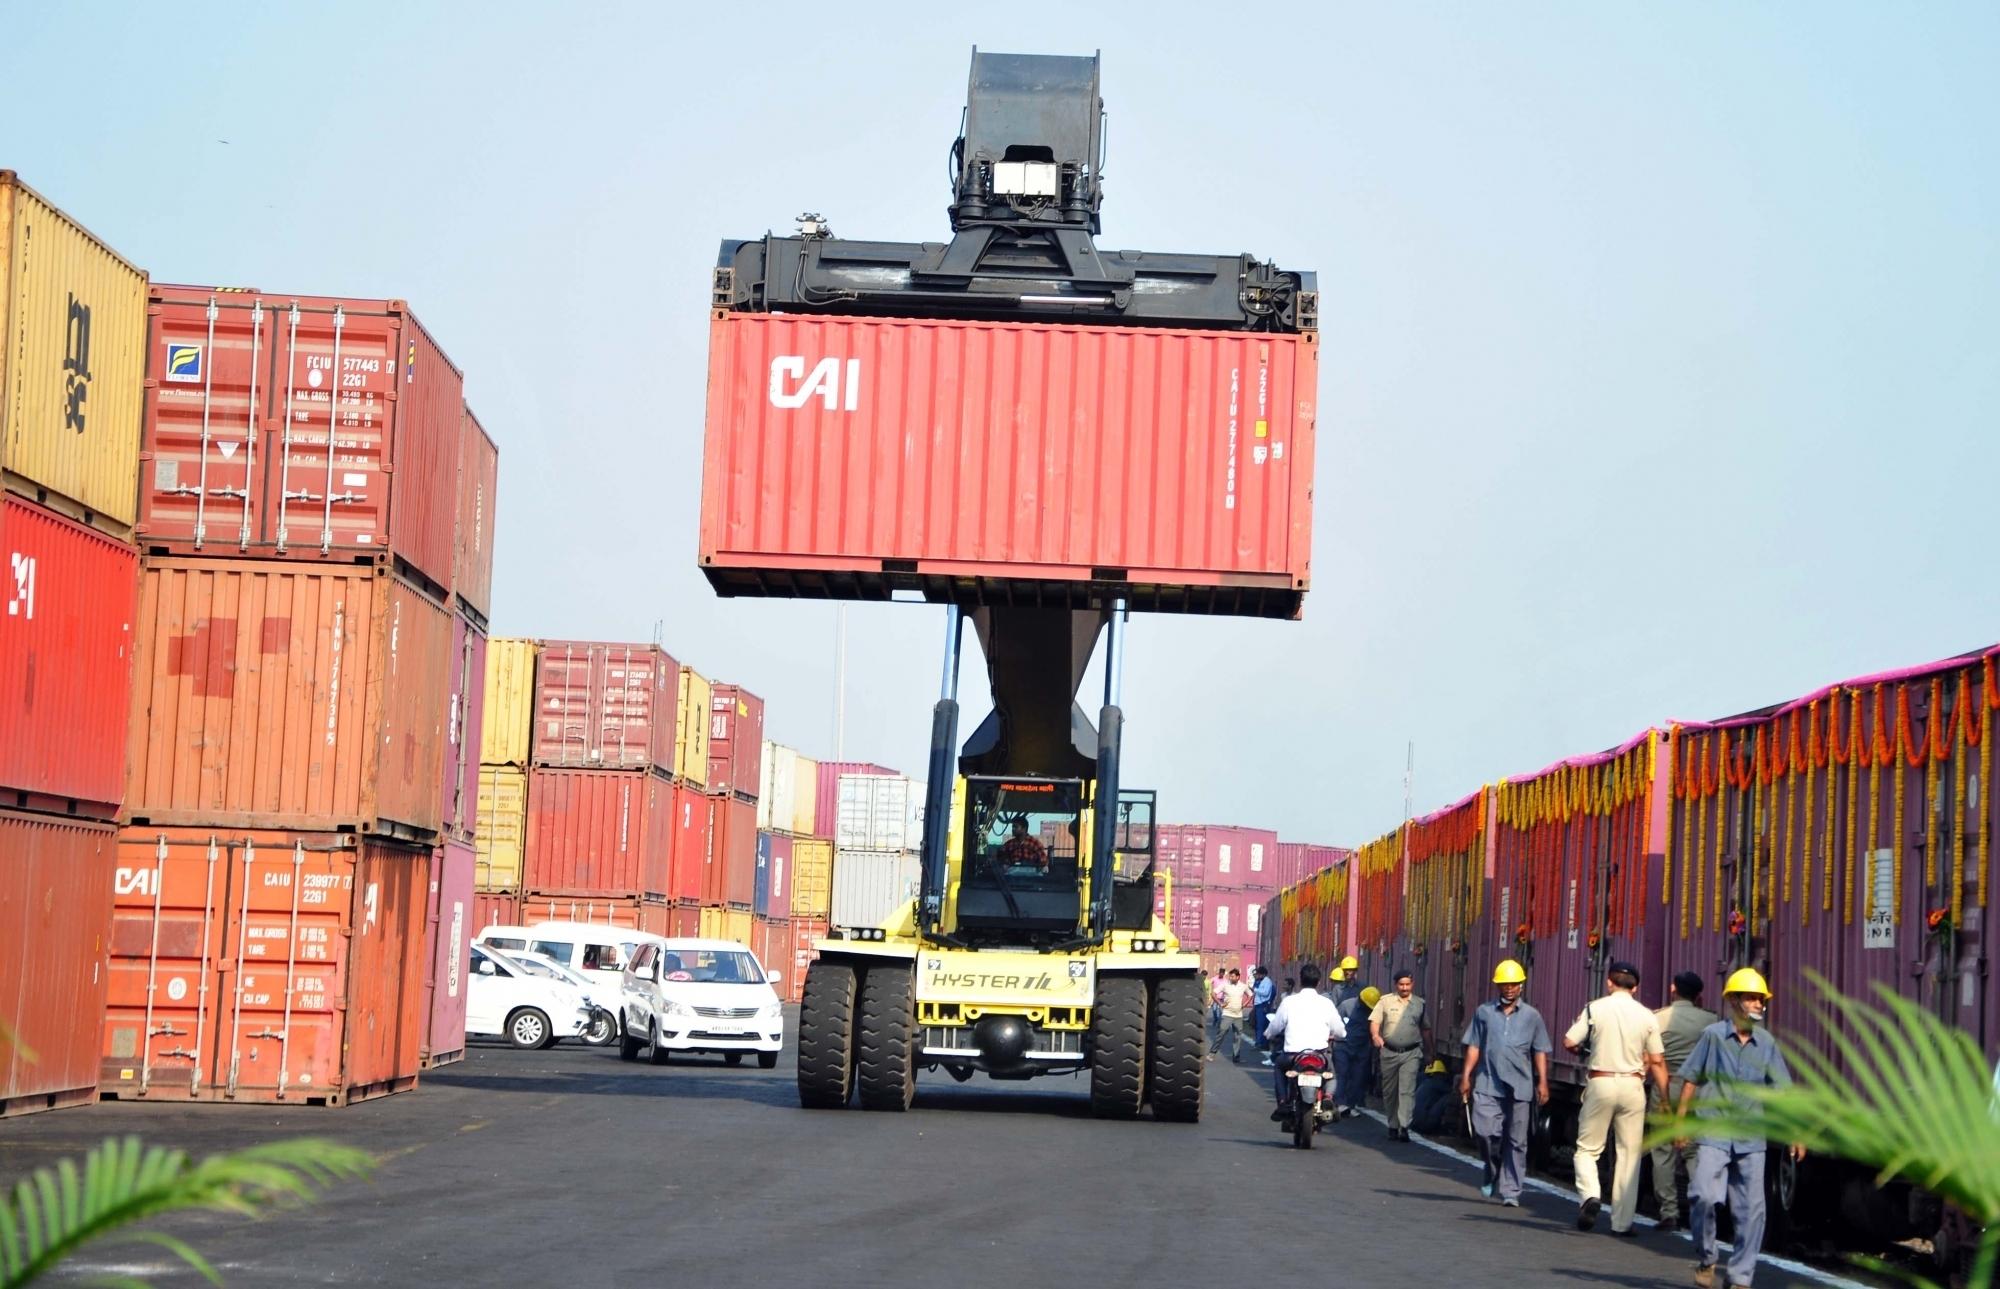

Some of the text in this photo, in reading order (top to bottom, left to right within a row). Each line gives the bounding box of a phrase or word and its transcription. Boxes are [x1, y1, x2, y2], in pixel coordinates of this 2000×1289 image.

[306, 356, 395, 374] FCIU 577443 7
[343, 373, 367, 387] 22G1
[770, 355, 860, 411] CAI
[311, 391, 329, 401] GROSS
[1229, 368, 1238, 416] CAIU
[1258, 368, 1267, 416] 22G1
[114, 867, 158, 895] CAI
[264, 873, 290, 886] CAIU
[303, 874, 339, 888] 239977
[932, 973, 1020, 990] HYSTER
